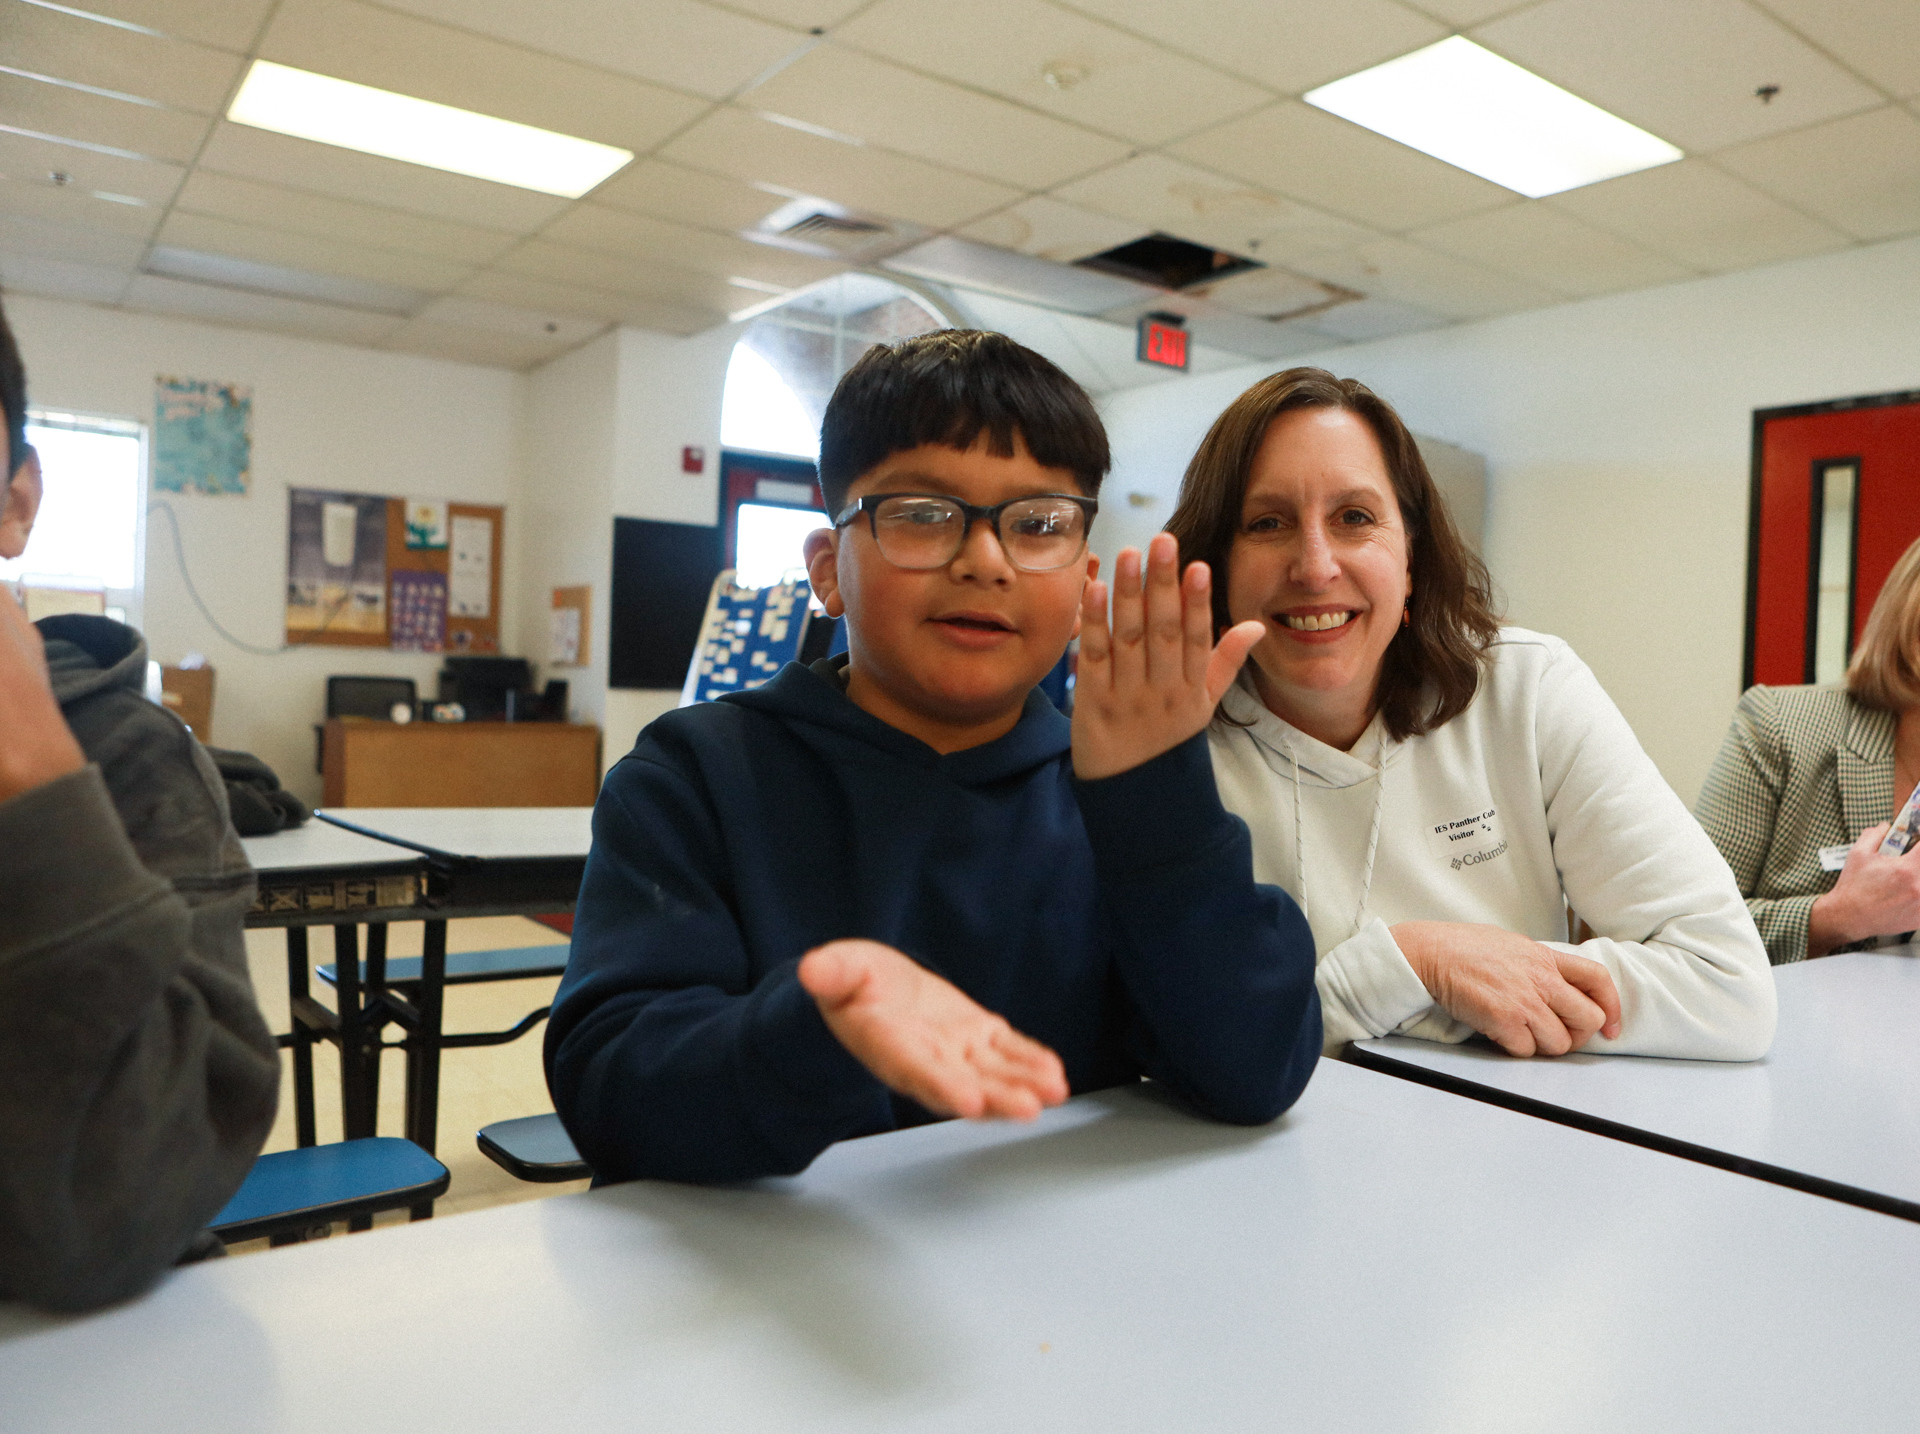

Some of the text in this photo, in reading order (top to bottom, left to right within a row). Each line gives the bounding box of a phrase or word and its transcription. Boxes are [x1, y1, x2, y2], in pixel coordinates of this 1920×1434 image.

[1434, 809, 1496, 834] IES Panther Cub
[1448, 830, 1475, 842] Visitor
